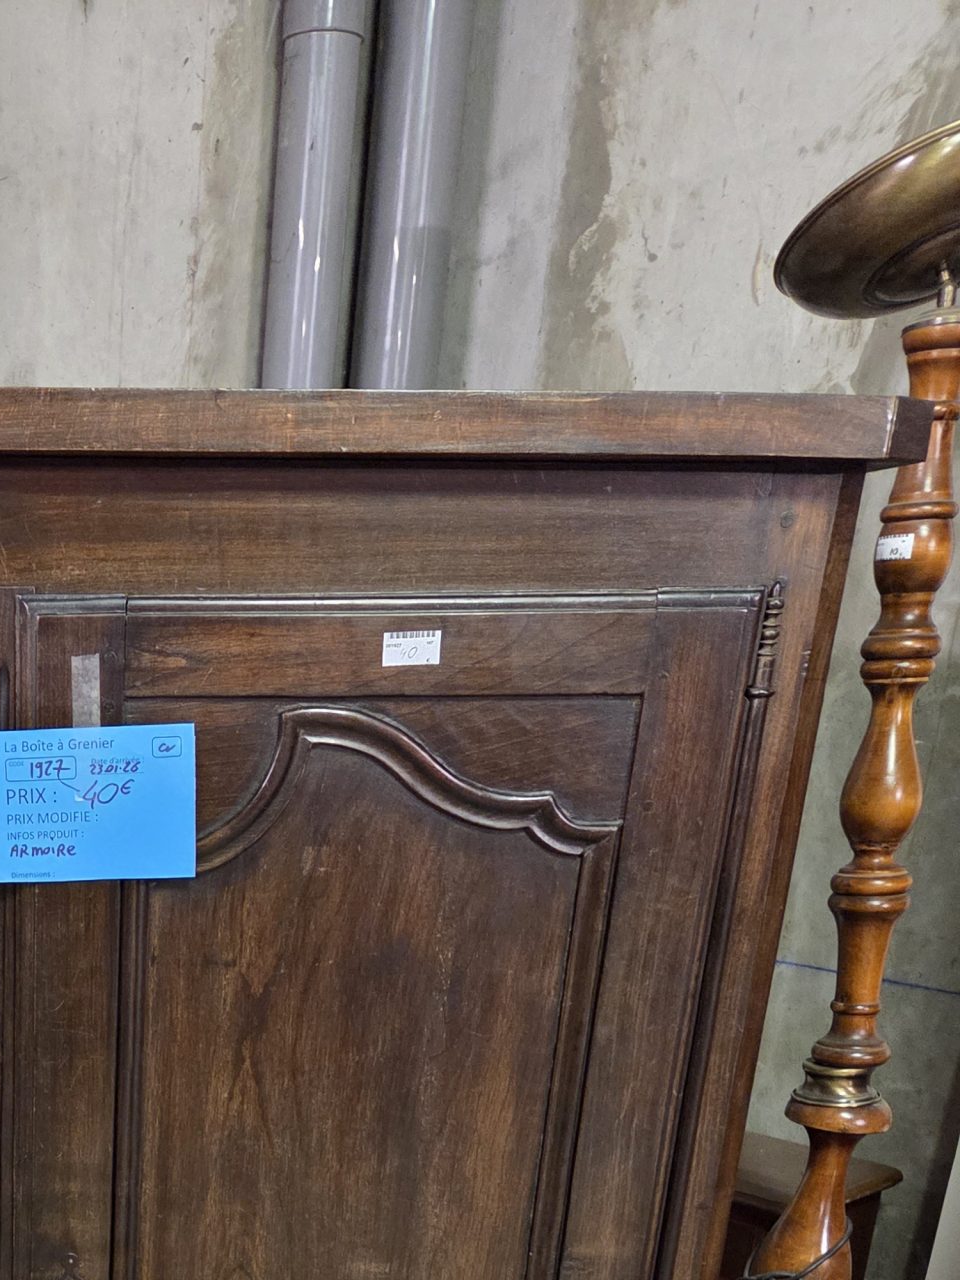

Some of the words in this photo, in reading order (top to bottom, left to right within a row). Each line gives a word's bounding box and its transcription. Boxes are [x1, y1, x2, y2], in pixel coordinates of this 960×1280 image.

[4, 741, 17, 753] La
[21, 739, 53, 752] Boîte
[57, 738, 64, 751] à
[68, 737, 115, 750] Grenier
[30, 758, 72, 780] 1927
[6, 787, 47, 805] PRIX
[6, 813, 34, 825] PRIX
[38, 811, 91, 823] MODIFIE
[7, 831, 35, 840] INFOS
[37, 829, 79, 840] PRODUIT
[11, 871, 51, 879] Dimensions
